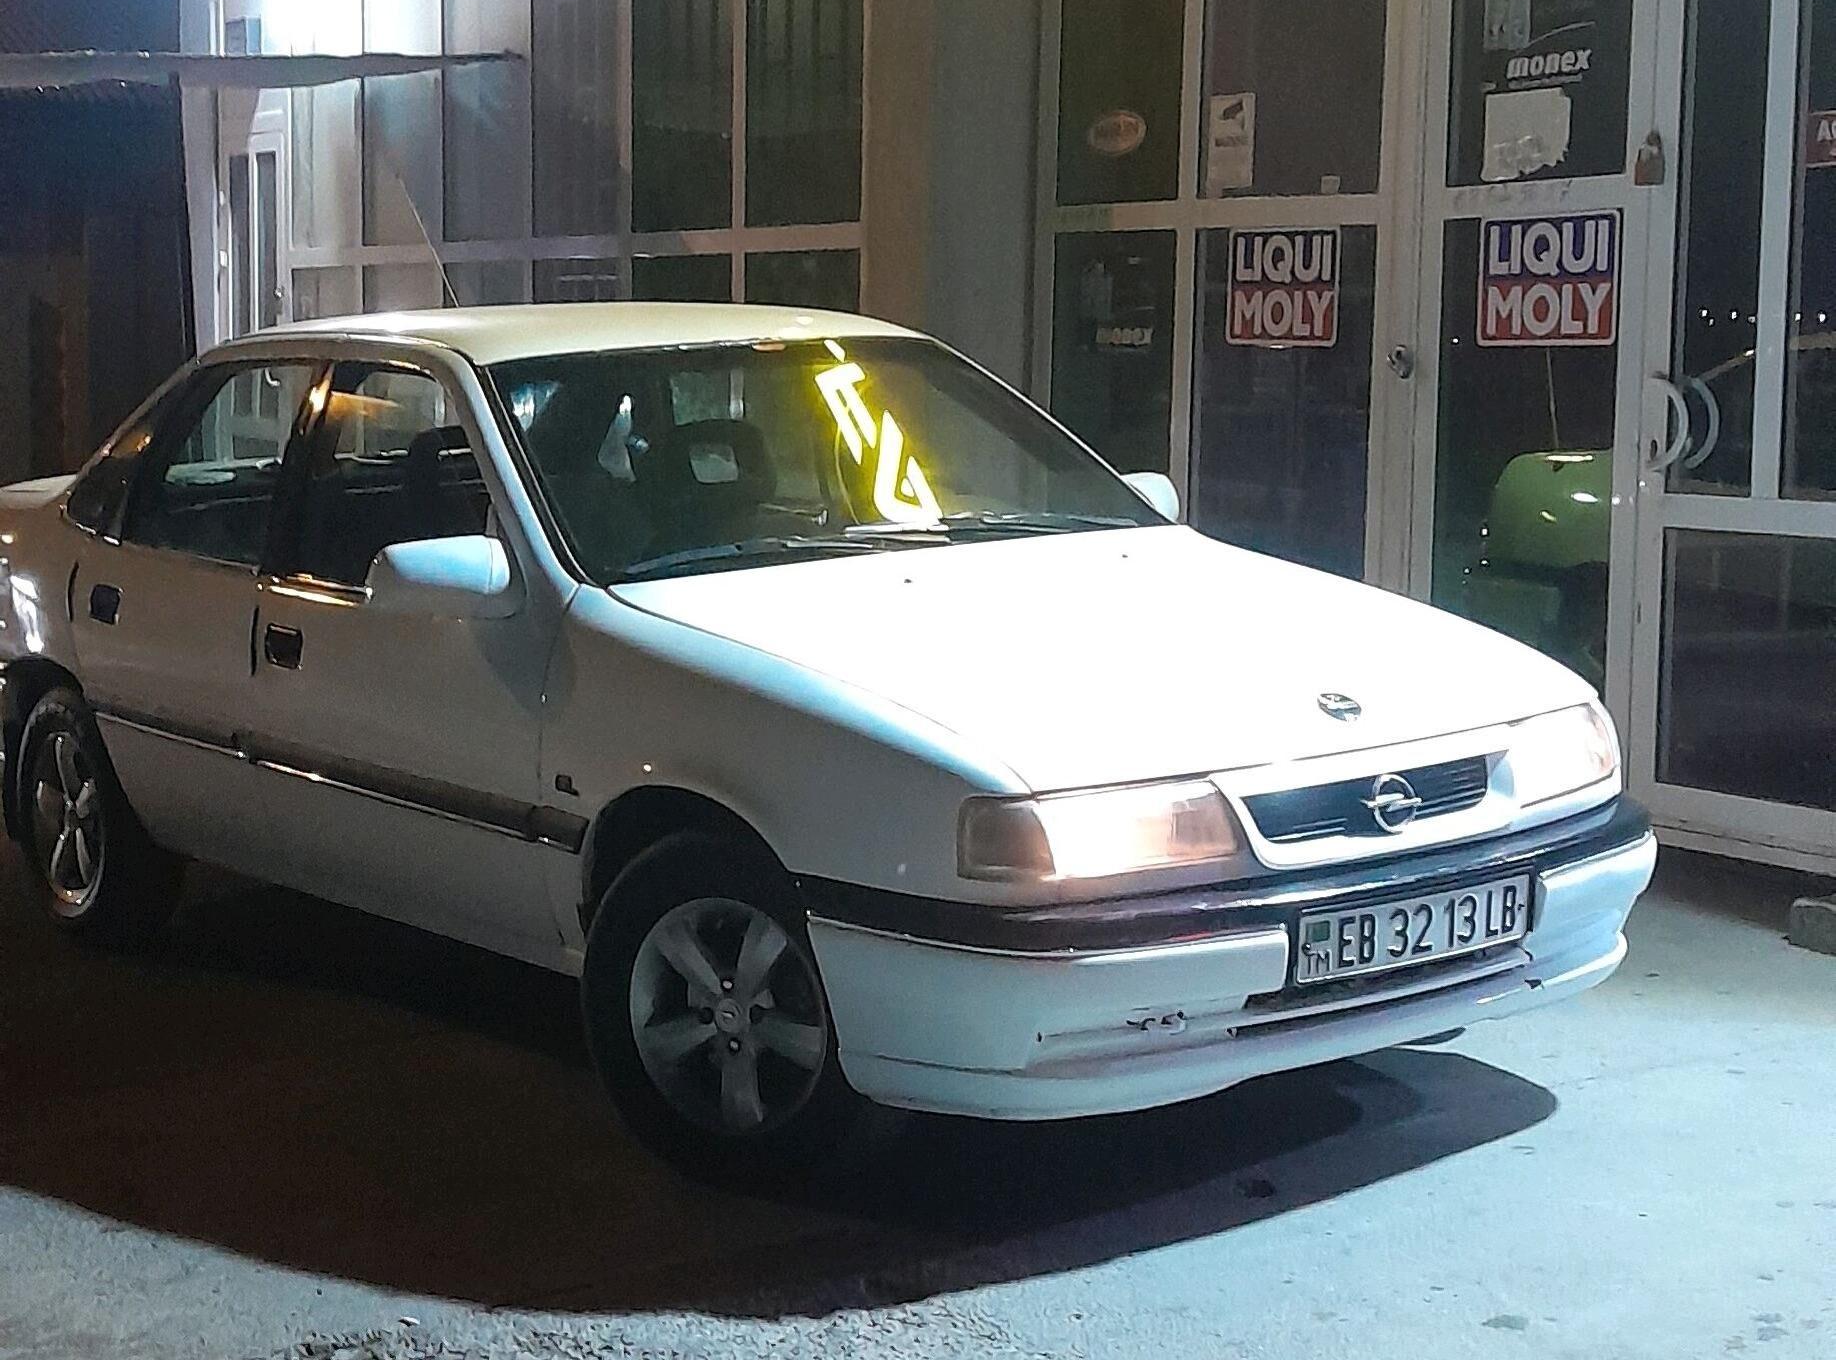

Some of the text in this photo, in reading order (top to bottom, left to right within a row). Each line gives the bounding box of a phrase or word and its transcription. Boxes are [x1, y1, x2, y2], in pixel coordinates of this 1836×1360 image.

[1506, 49, 1591, 79] monex
[1236, 235, 1332, 283] LIQUI
[1489, 220, 1610, 275] LIQUI
[1233, 290, 1334, 336] MOLY
[1486, 283, 1611, 336] MOLY
[1338, 885, 1516, 968] EB 32 13 LB
